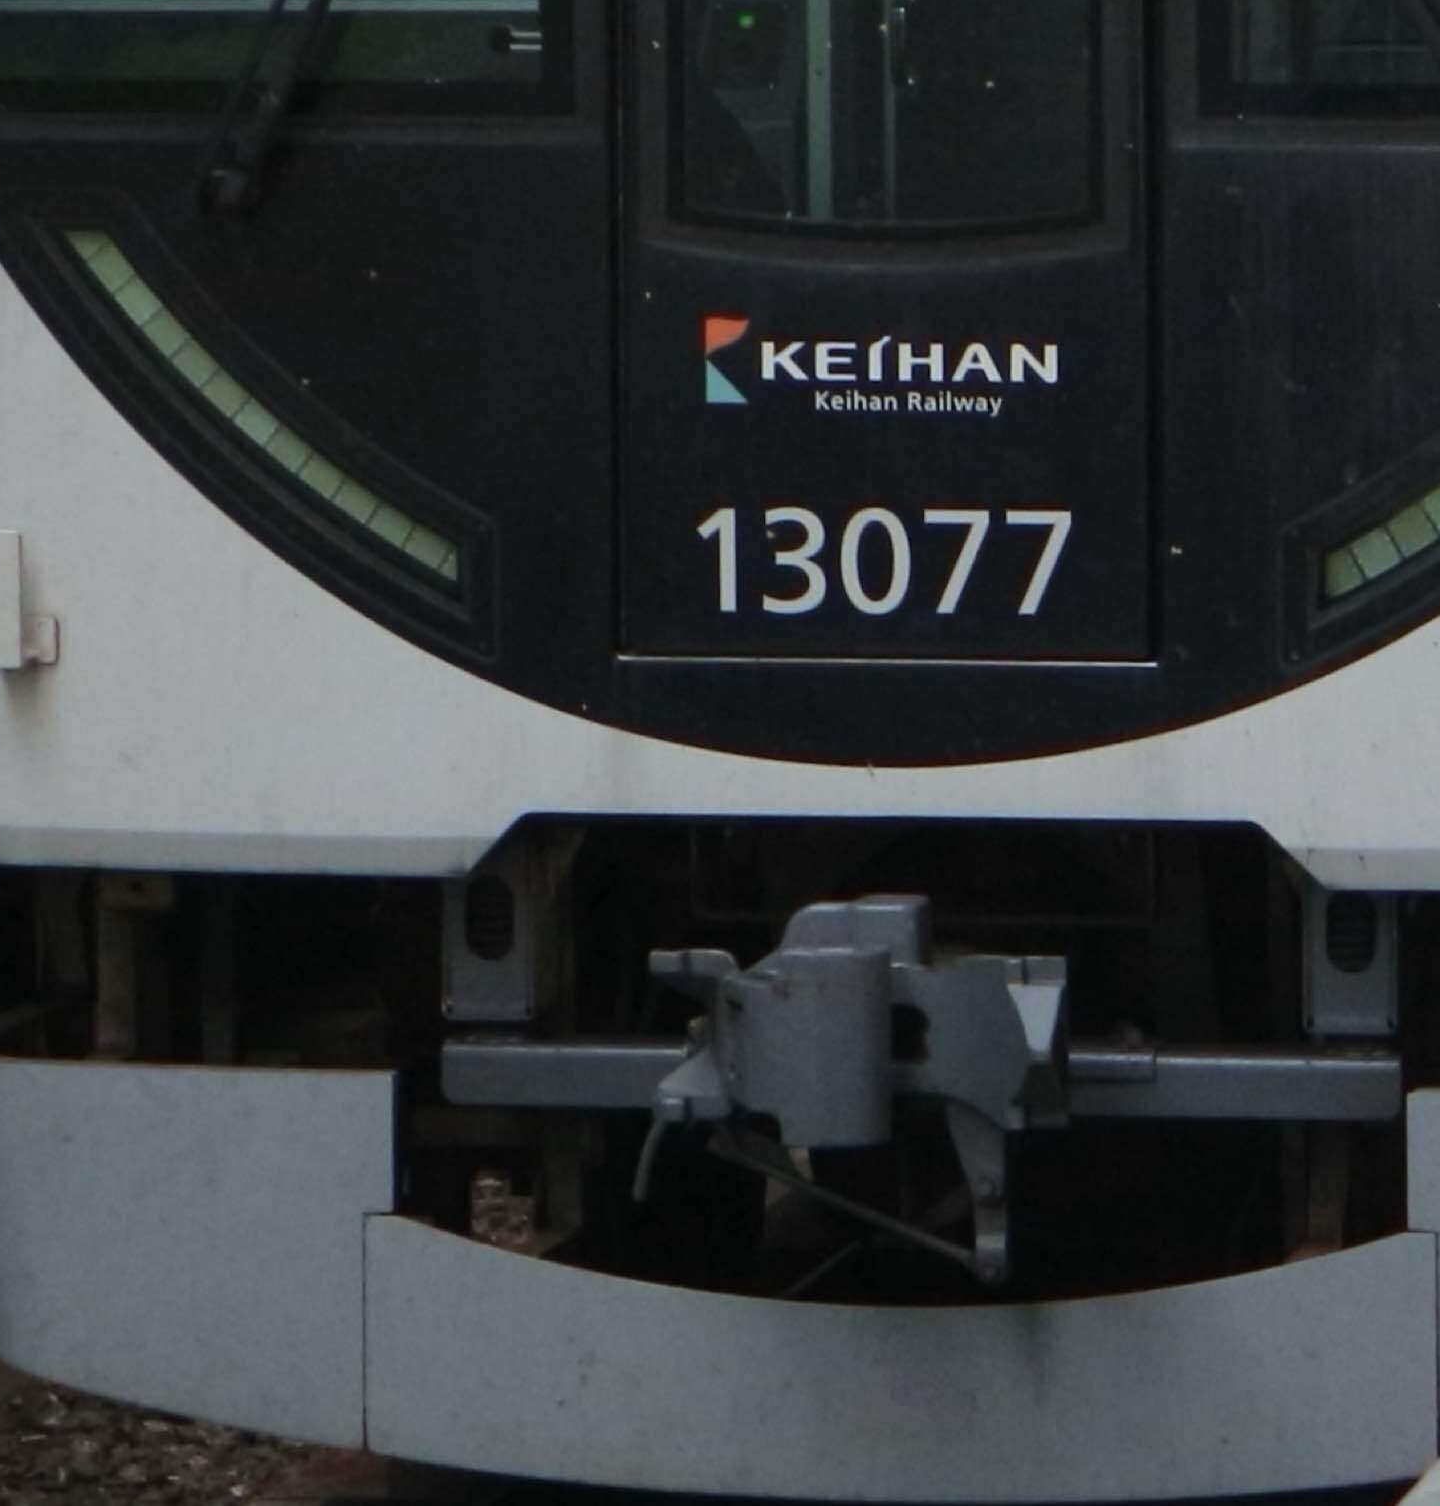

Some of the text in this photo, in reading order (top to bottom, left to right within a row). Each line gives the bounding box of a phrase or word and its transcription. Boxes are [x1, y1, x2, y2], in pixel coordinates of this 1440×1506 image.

[814, 389, 1003, 417] Keihan Railway
[696, 506, 1073, 616] 13077
